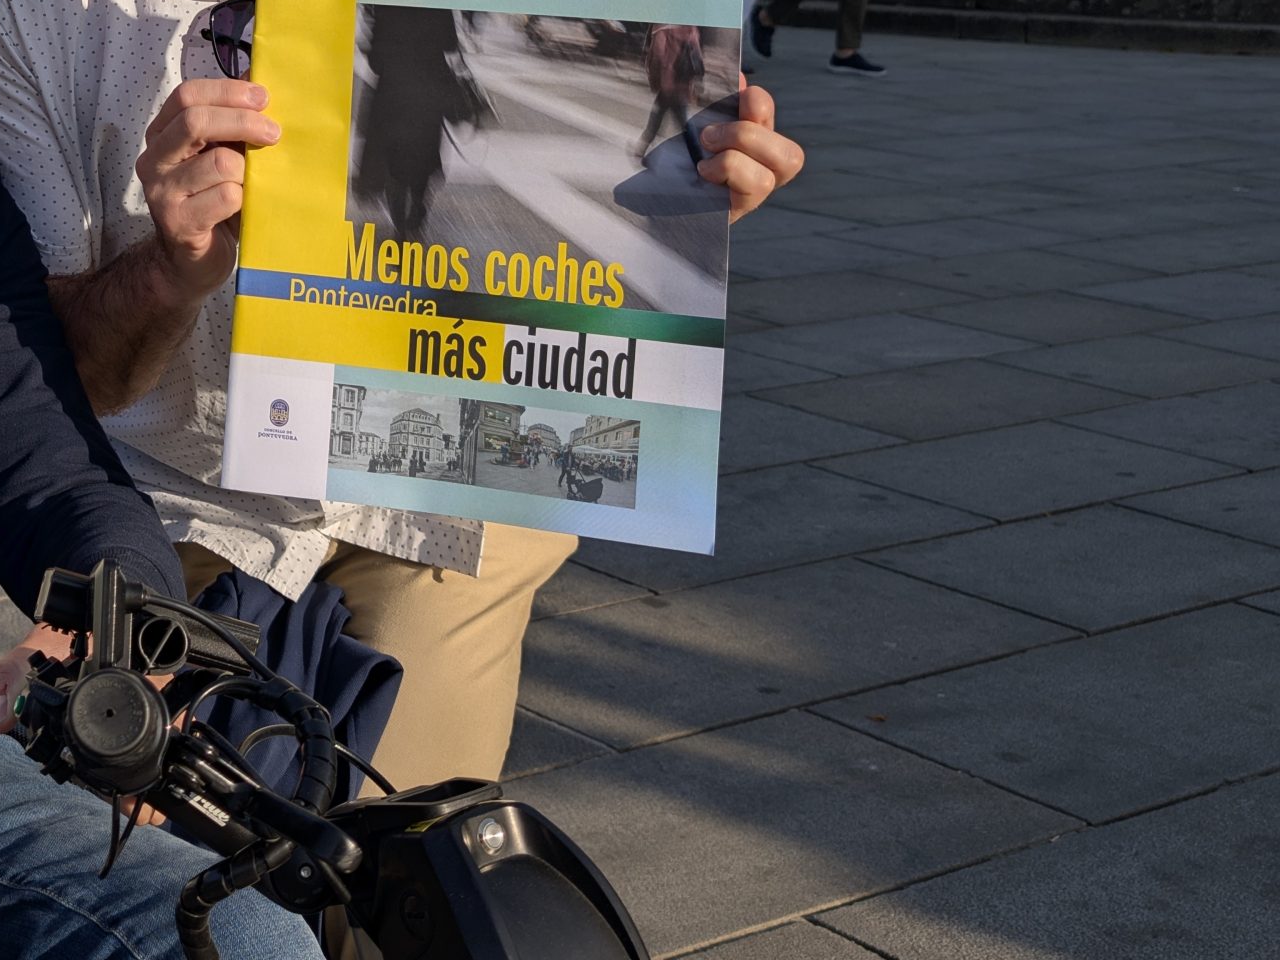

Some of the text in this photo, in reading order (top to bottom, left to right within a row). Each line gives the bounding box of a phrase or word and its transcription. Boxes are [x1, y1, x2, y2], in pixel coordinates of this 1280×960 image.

[343, 220, 626, 309] Menos coches
[289, 278, 439, 318] Pontevedra
[408, 319, 638, 400] más ciudad
[257, 431, 298, 442] PONTEVEDRA
